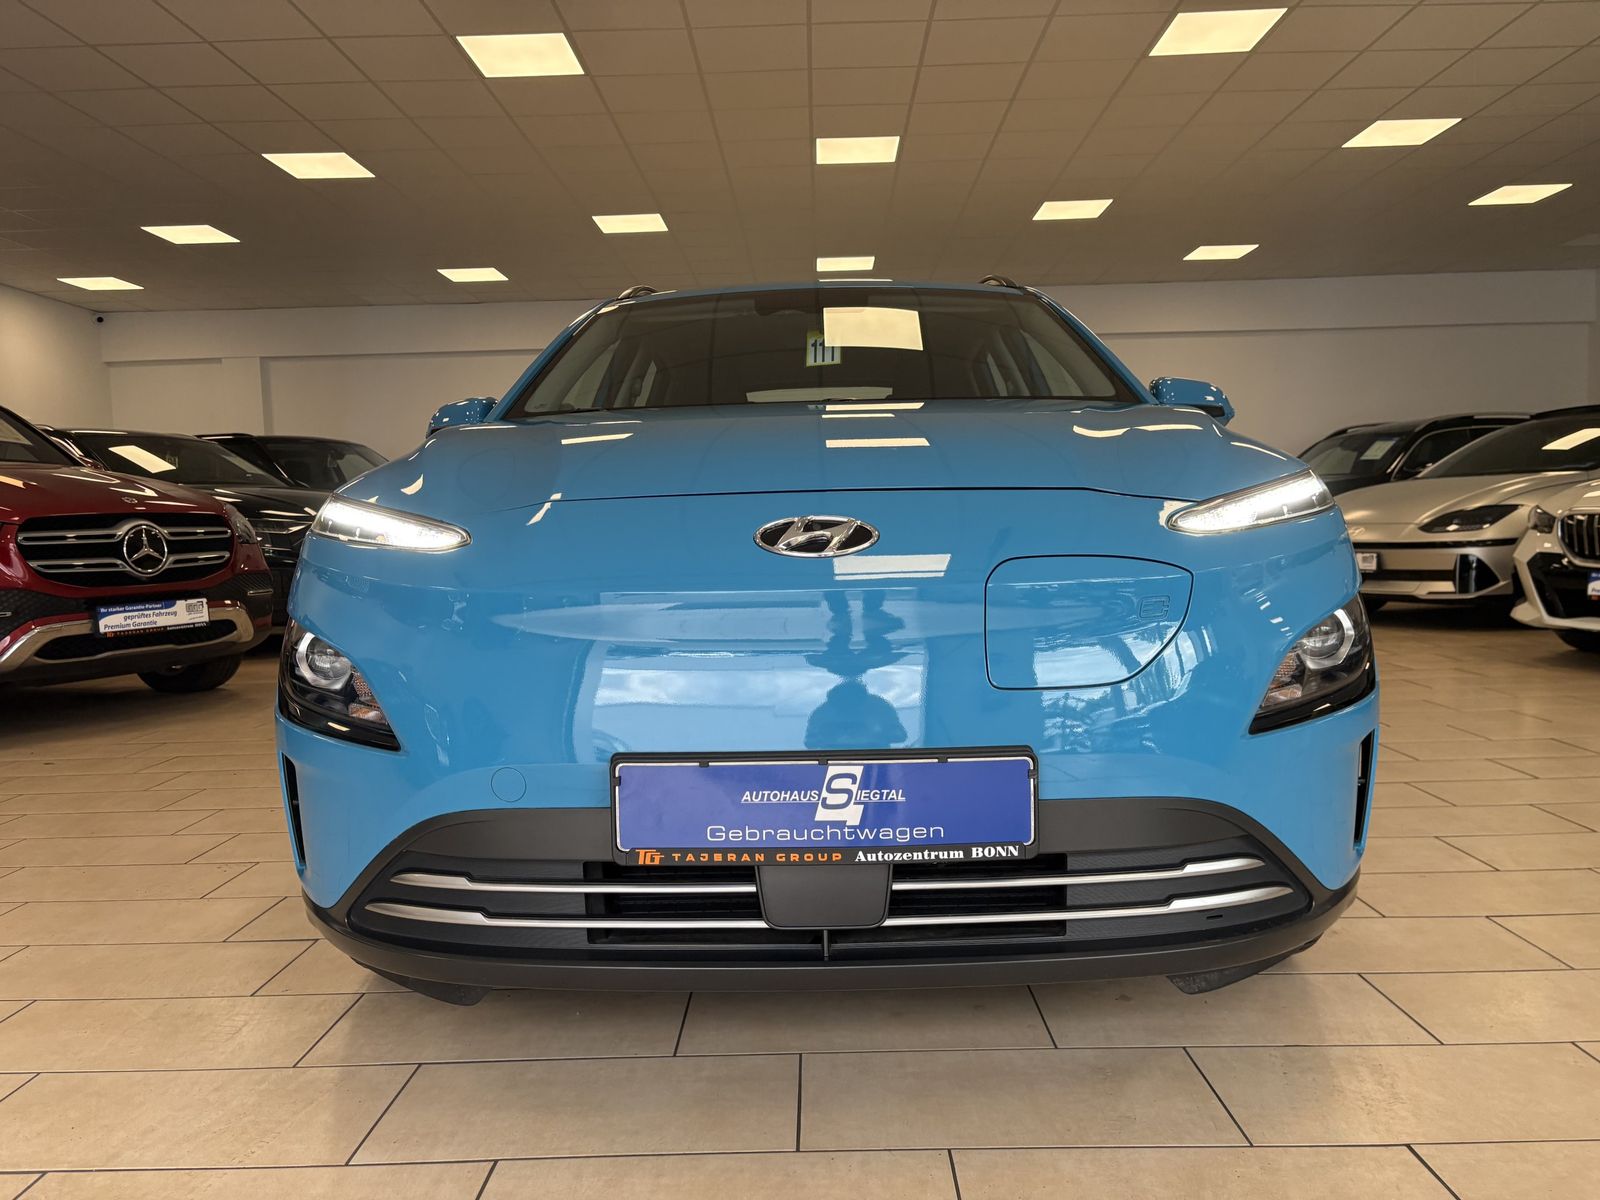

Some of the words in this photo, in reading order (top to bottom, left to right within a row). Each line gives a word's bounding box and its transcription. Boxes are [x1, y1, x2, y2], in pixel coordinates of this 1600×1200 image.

[123, 612, 151, 622] geprüftes
[152, 610, 178, 618] Fahrzeug
[104, 622, 131, 630] Premium
[132, 620, 157, 628] Garantie
[741, 790, 819, 803] AUTOHAUS
[706, 824, 945, 843] Gebrauchtwagen
[671, 852, 765, 863] TAJERAN
[775, 852, 843, 863] GROUP
[853, 848, 964, 863] Autozentrum
[971, 845, 1020, 859] BONN
